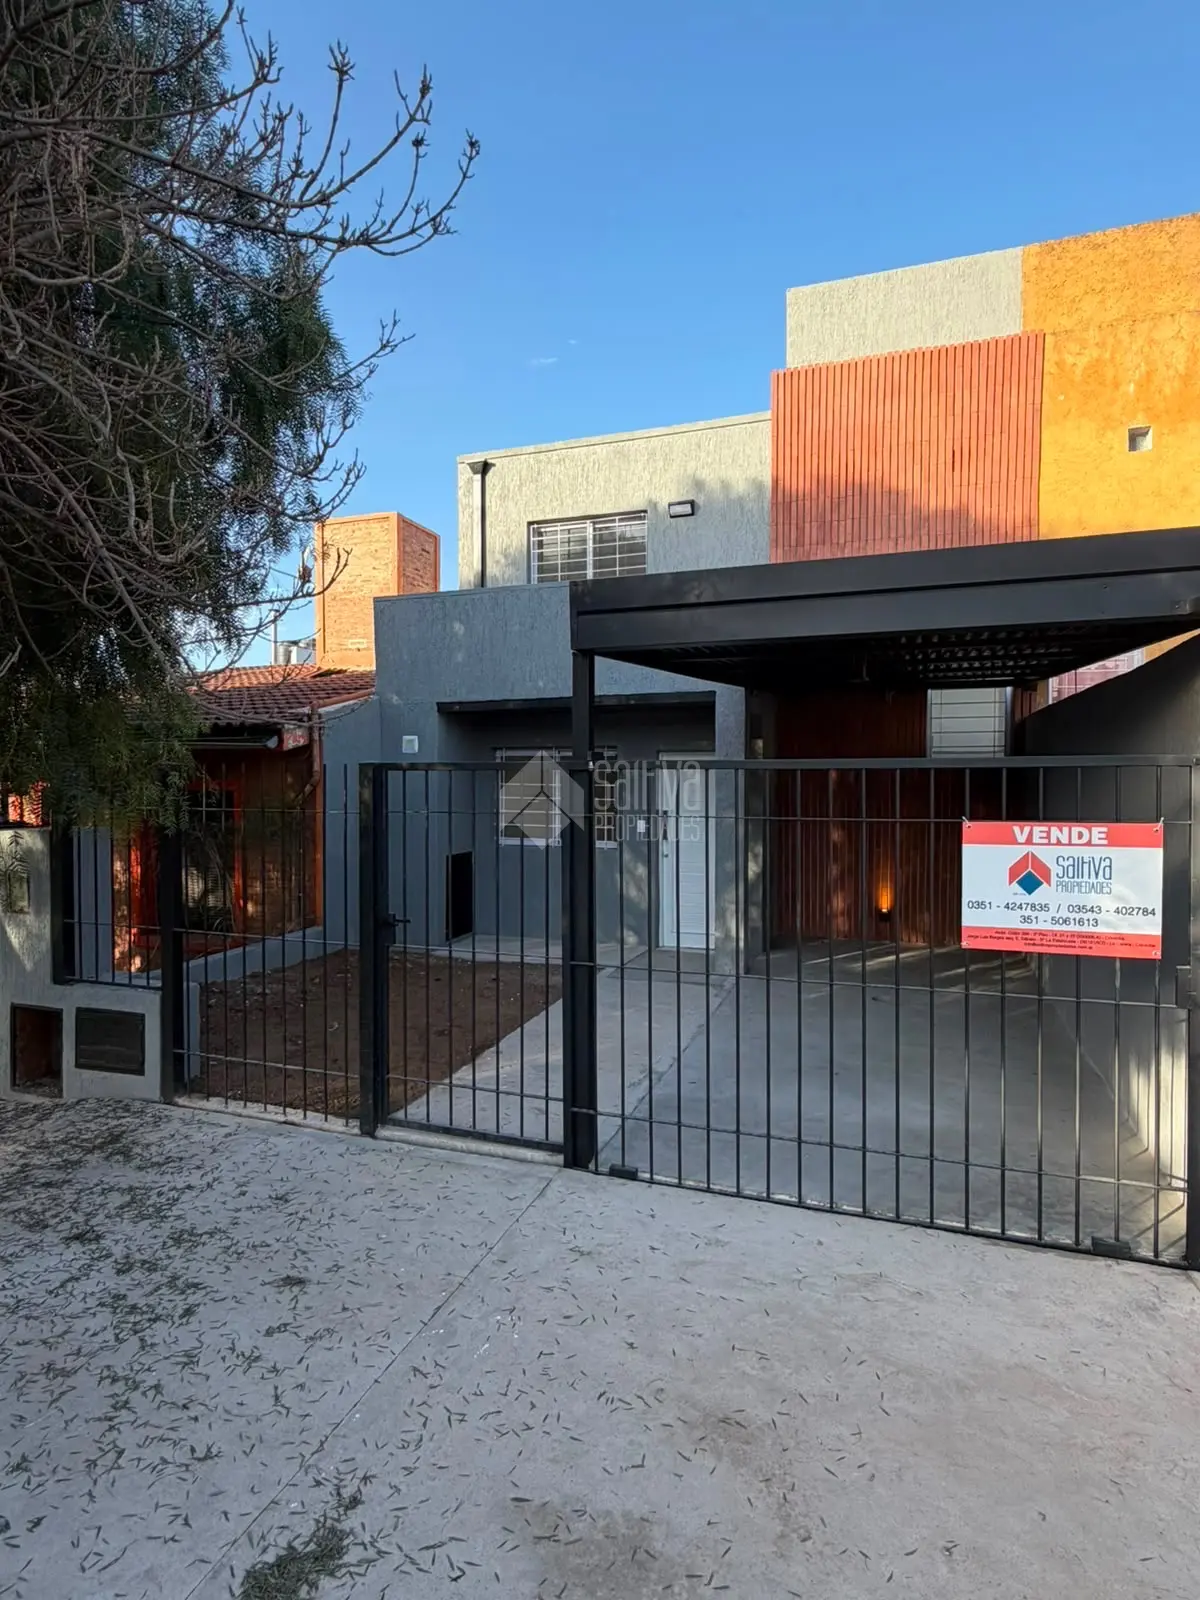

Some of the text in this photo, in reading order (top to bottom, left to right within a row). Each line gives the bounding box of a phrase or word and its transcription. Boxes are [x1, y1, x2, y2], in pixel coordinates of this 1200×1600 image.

[1012, 825, 1109, 845] VENDE
[1055, 880, 1112, 895] PROPIEDADES
[967, 900, 992, 910] 0351
[1003, 902, 1050, 913] 4247835
[1056, 903, 1061, 914] /
[1067, 904, 1102, 914] 03543
[1113, 906, 1156, 917] 402784
[1019, 915, 1039, 925] 351
[1051, 916, 1099, 927] 5061613
